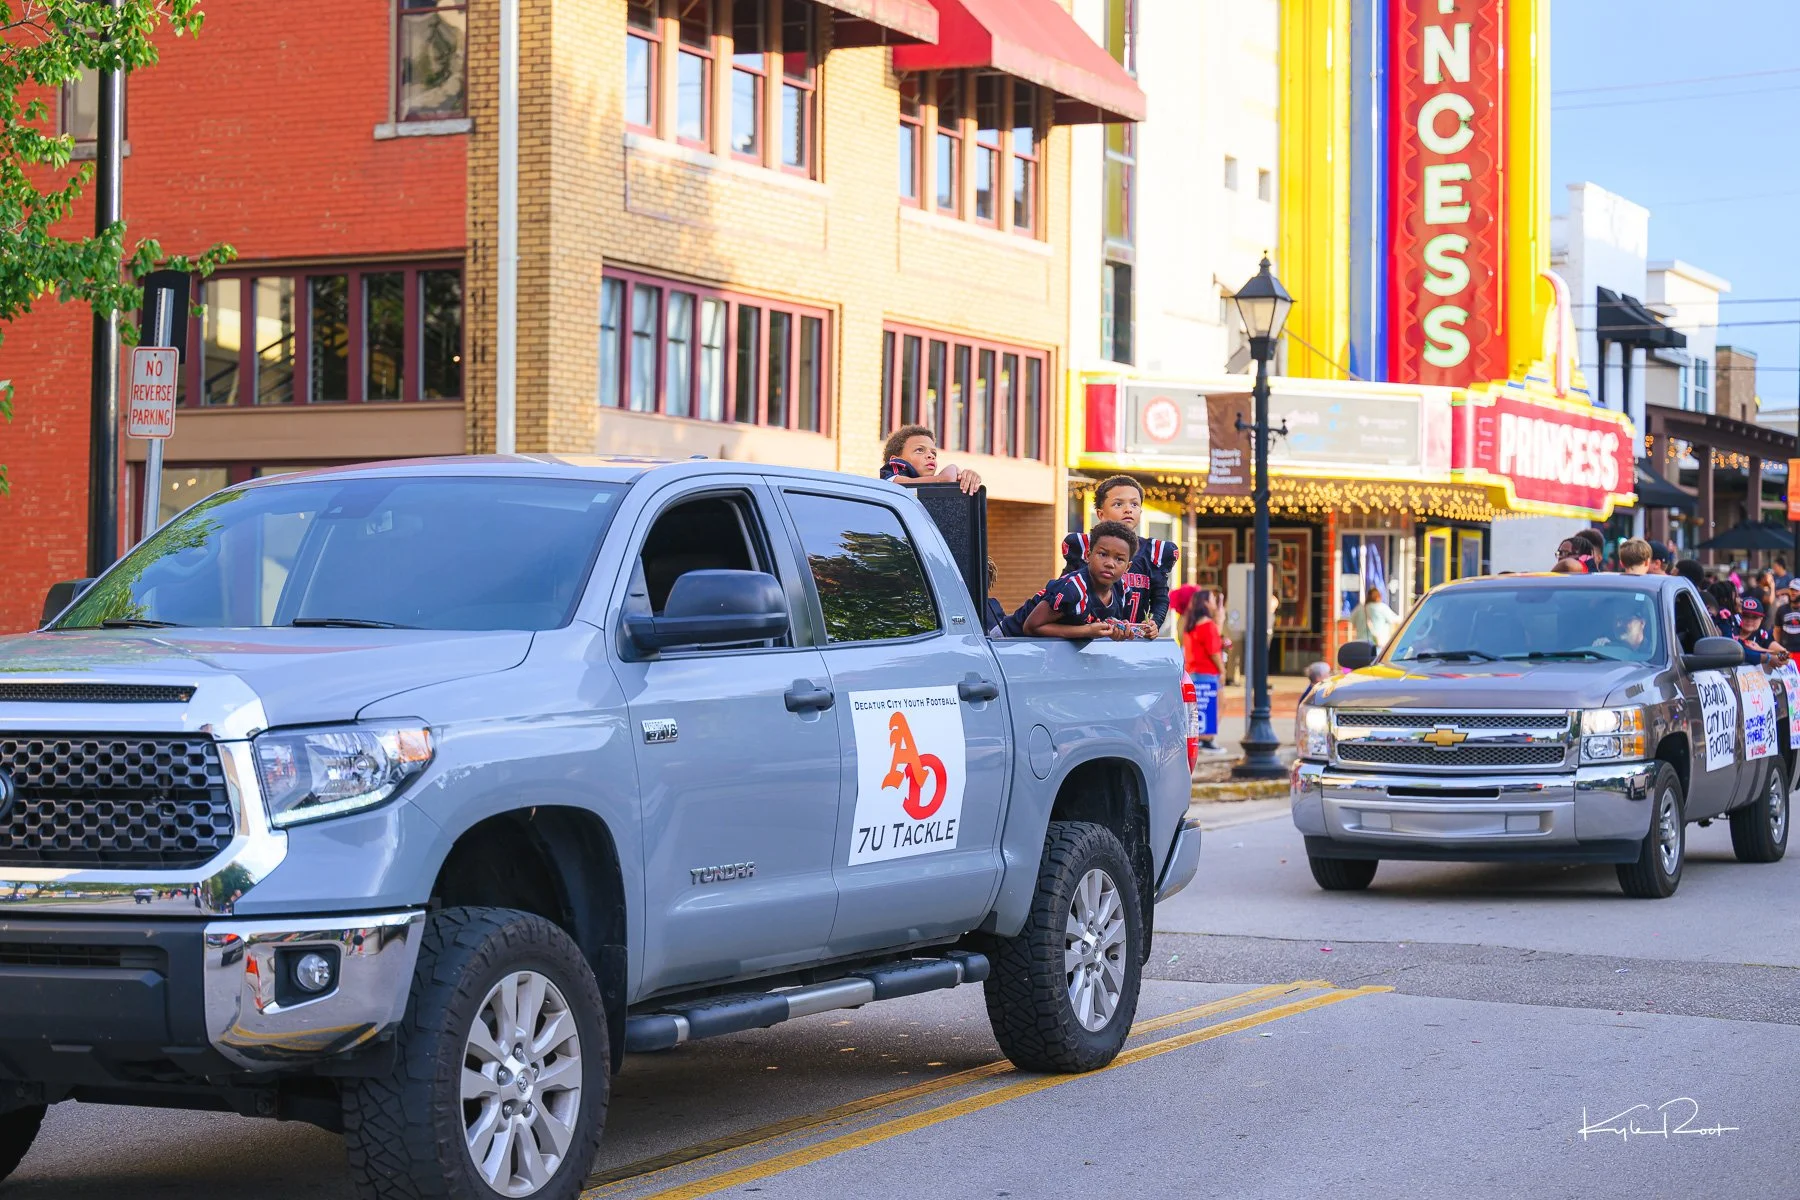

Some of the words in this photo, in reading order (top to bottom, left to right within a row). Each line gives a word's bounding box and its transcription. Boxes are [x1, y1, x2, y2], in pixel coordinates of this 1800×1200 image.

[1417, 0, 1475, 367] NCESS
[145, 360, 163, 377] NO
[133, 384, 173, 401] REVERSE
[131, 408, 170, 426] PARKING
[1499, 411, 1620, 491] PRINCESS
[1127, 591, 1141, 623] 7
[887, 699, 902, 710] CITY
[903, 698, 925, 708] YOUTH
[926, 697, 957, 707] FOOTBALL
[857, 825, 886, 854] 7U
[893, 818, 957, 848] TACKLE
[690, 861, 757, 884] TUNDRA
